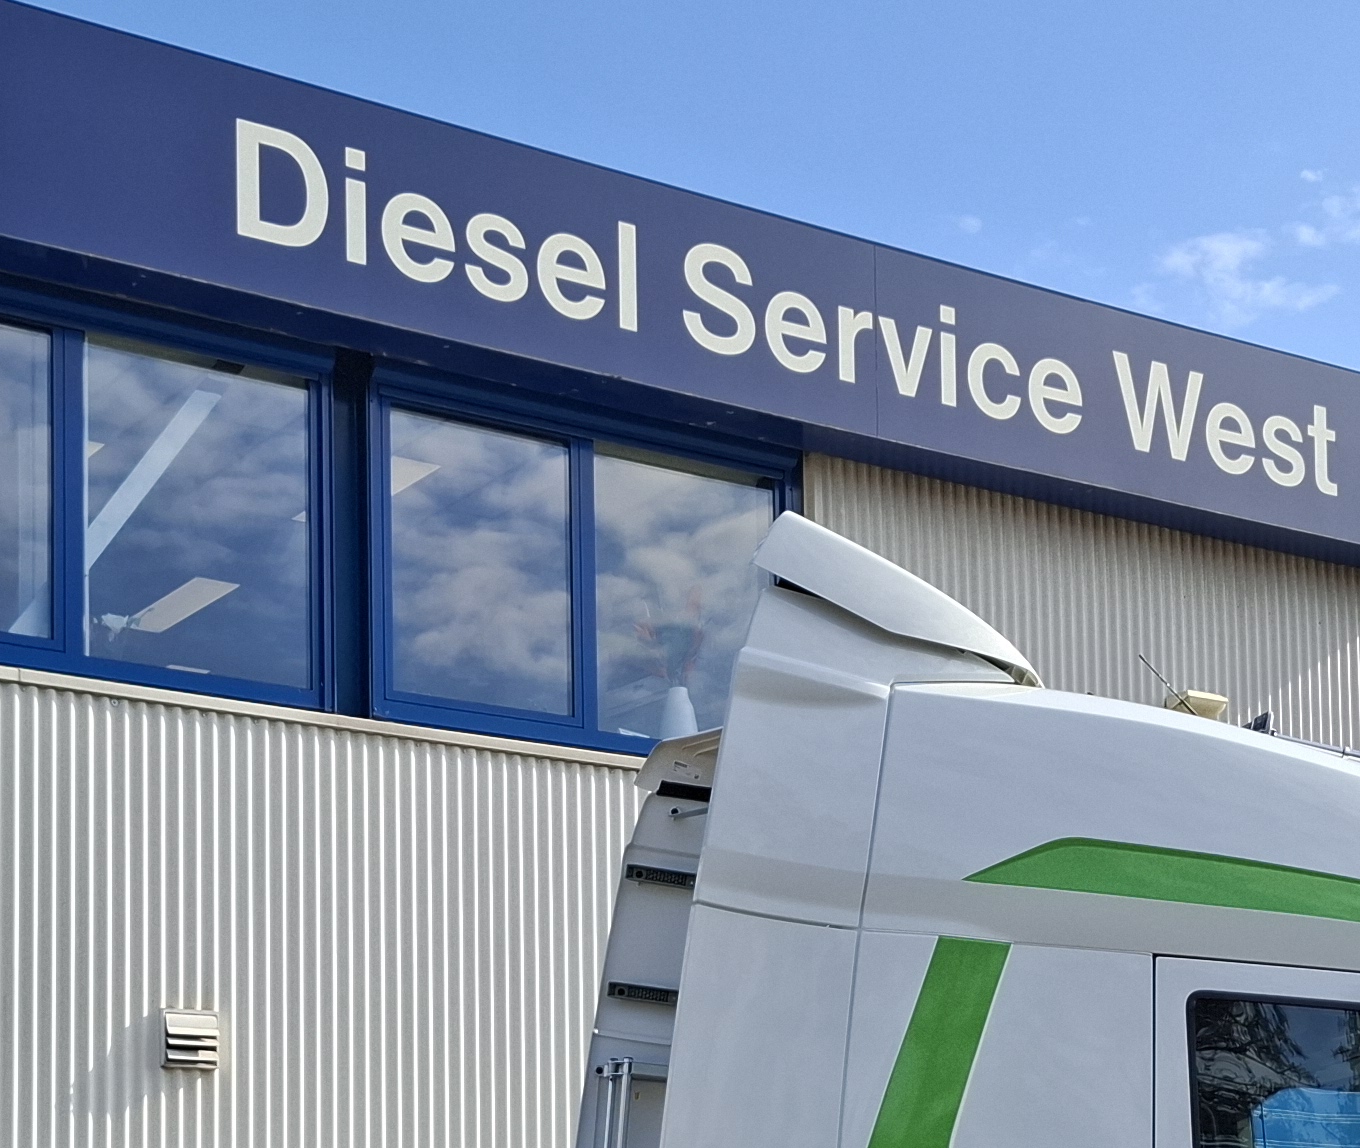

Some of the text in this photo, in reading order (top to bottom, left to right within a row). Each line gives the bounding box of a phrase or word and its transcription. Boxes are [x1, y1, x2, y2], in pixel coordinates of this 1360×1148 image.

[236, 118, 1338, 496] Diesel Service West
